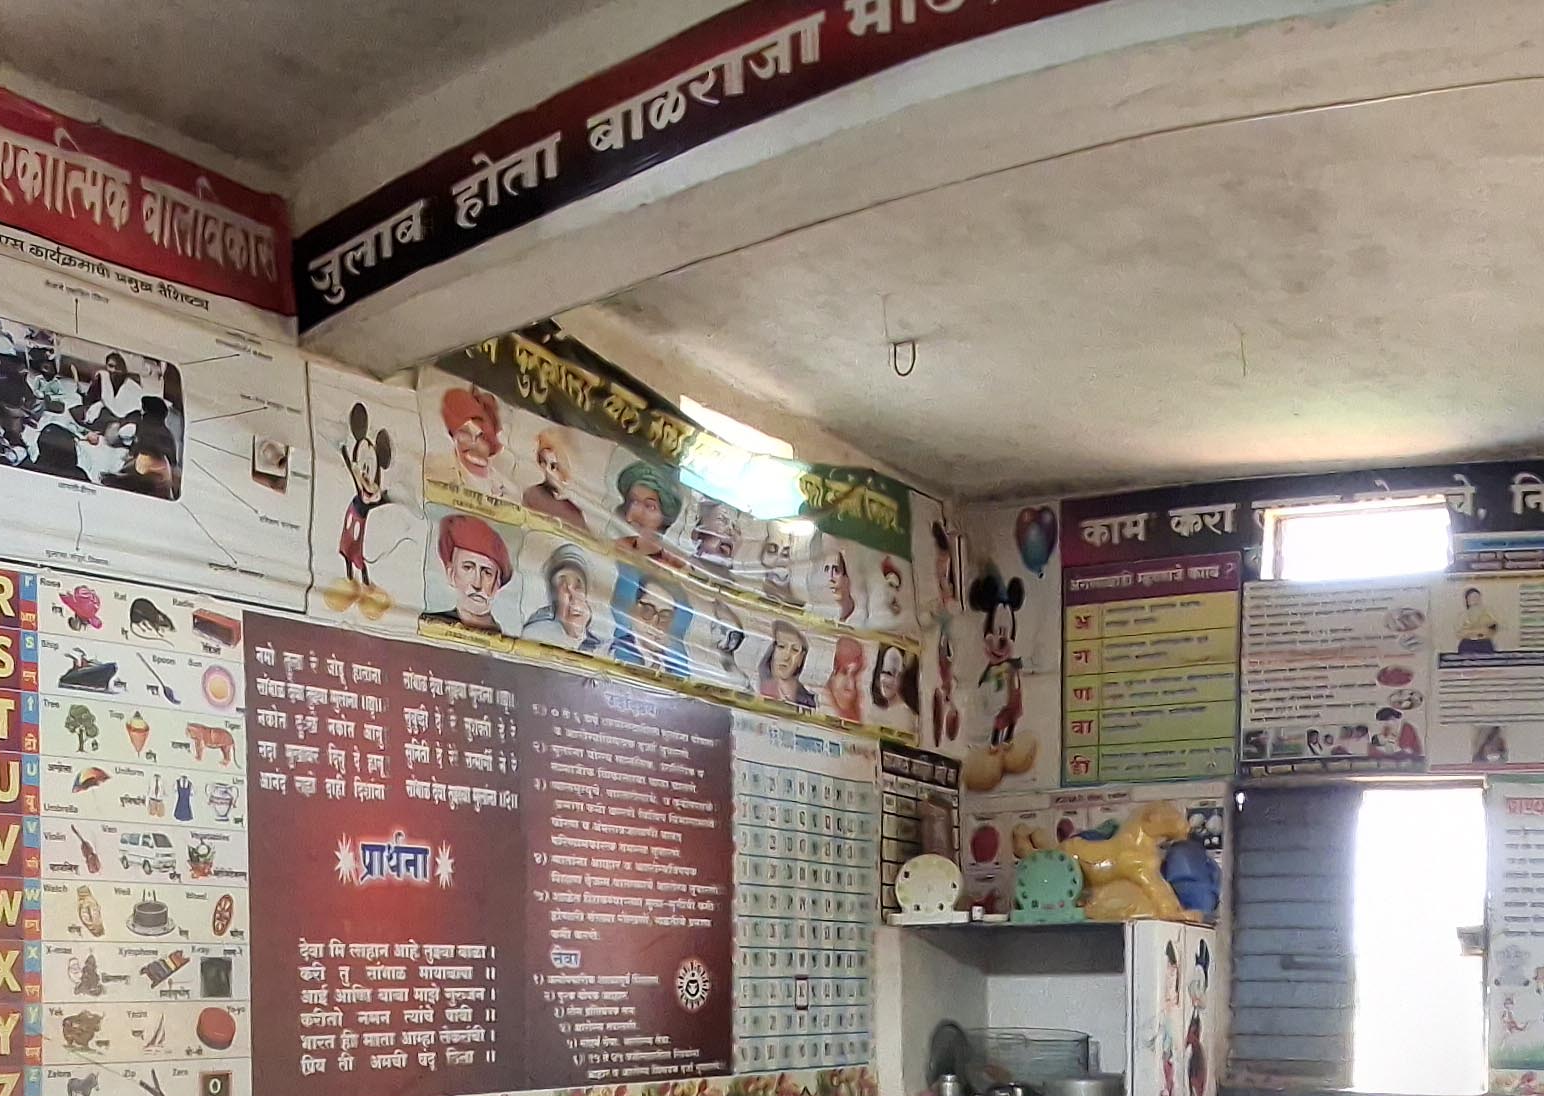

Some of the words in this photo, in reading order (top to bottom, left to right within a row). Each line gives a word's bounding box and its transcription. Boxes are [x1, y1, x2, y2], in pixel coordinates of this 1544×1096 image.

[308, 198, 429, 305] जुलाब
[452, 130, 562, 230] होता
[587, 12, 826, 153] बाळराजा
[1080, 512, 1149, 547] काम
[1168, 503, 1236, 537] करा
[360, 830, 431, 882] प्रार्थना
